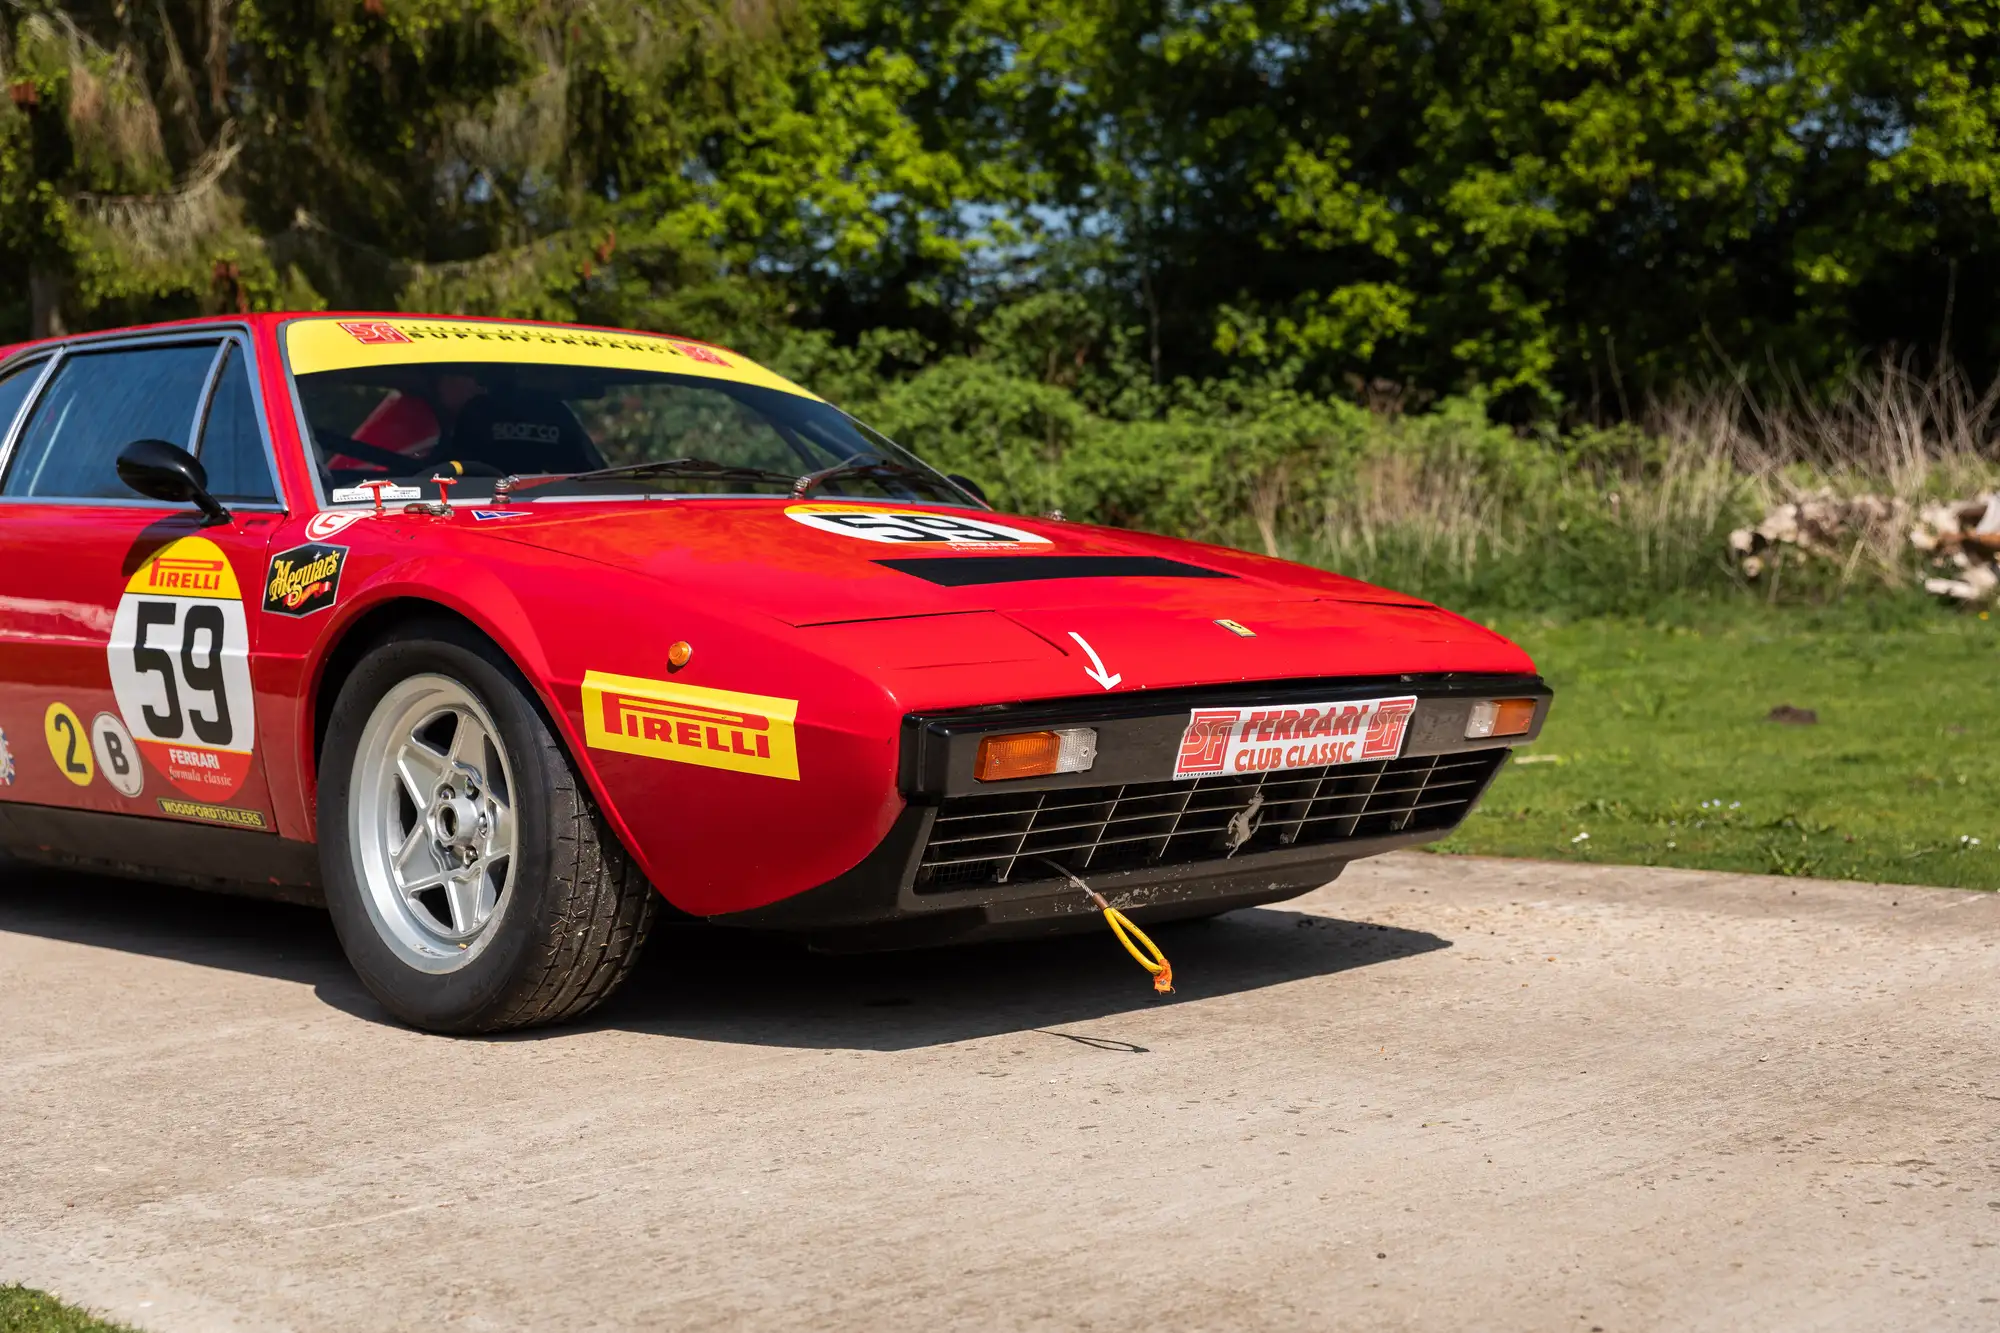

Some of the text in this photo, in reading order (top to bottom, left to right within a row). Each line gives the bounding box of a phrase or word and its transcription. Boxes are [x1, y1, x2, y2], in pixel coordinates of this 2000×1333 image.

[808, 514, 1020, 541] 59
[149, 557, 224, 590] PIRELLI
[133, 601, 233, 745] 59
[601, 691, 770, 758] PIRELLI
[1239, 705, 1370, 743] FERRARI
[54, 713, 88, 774] 2
[103, 731, 130, 775] B
[168, 748, 220, 769] FERRARI
[1234, 740, 1356, 772] CLUB CLASSIC
[169, 766, 232, 786] formula classic
[162, 801, 262, 826] WOODFORDTRAILERS
